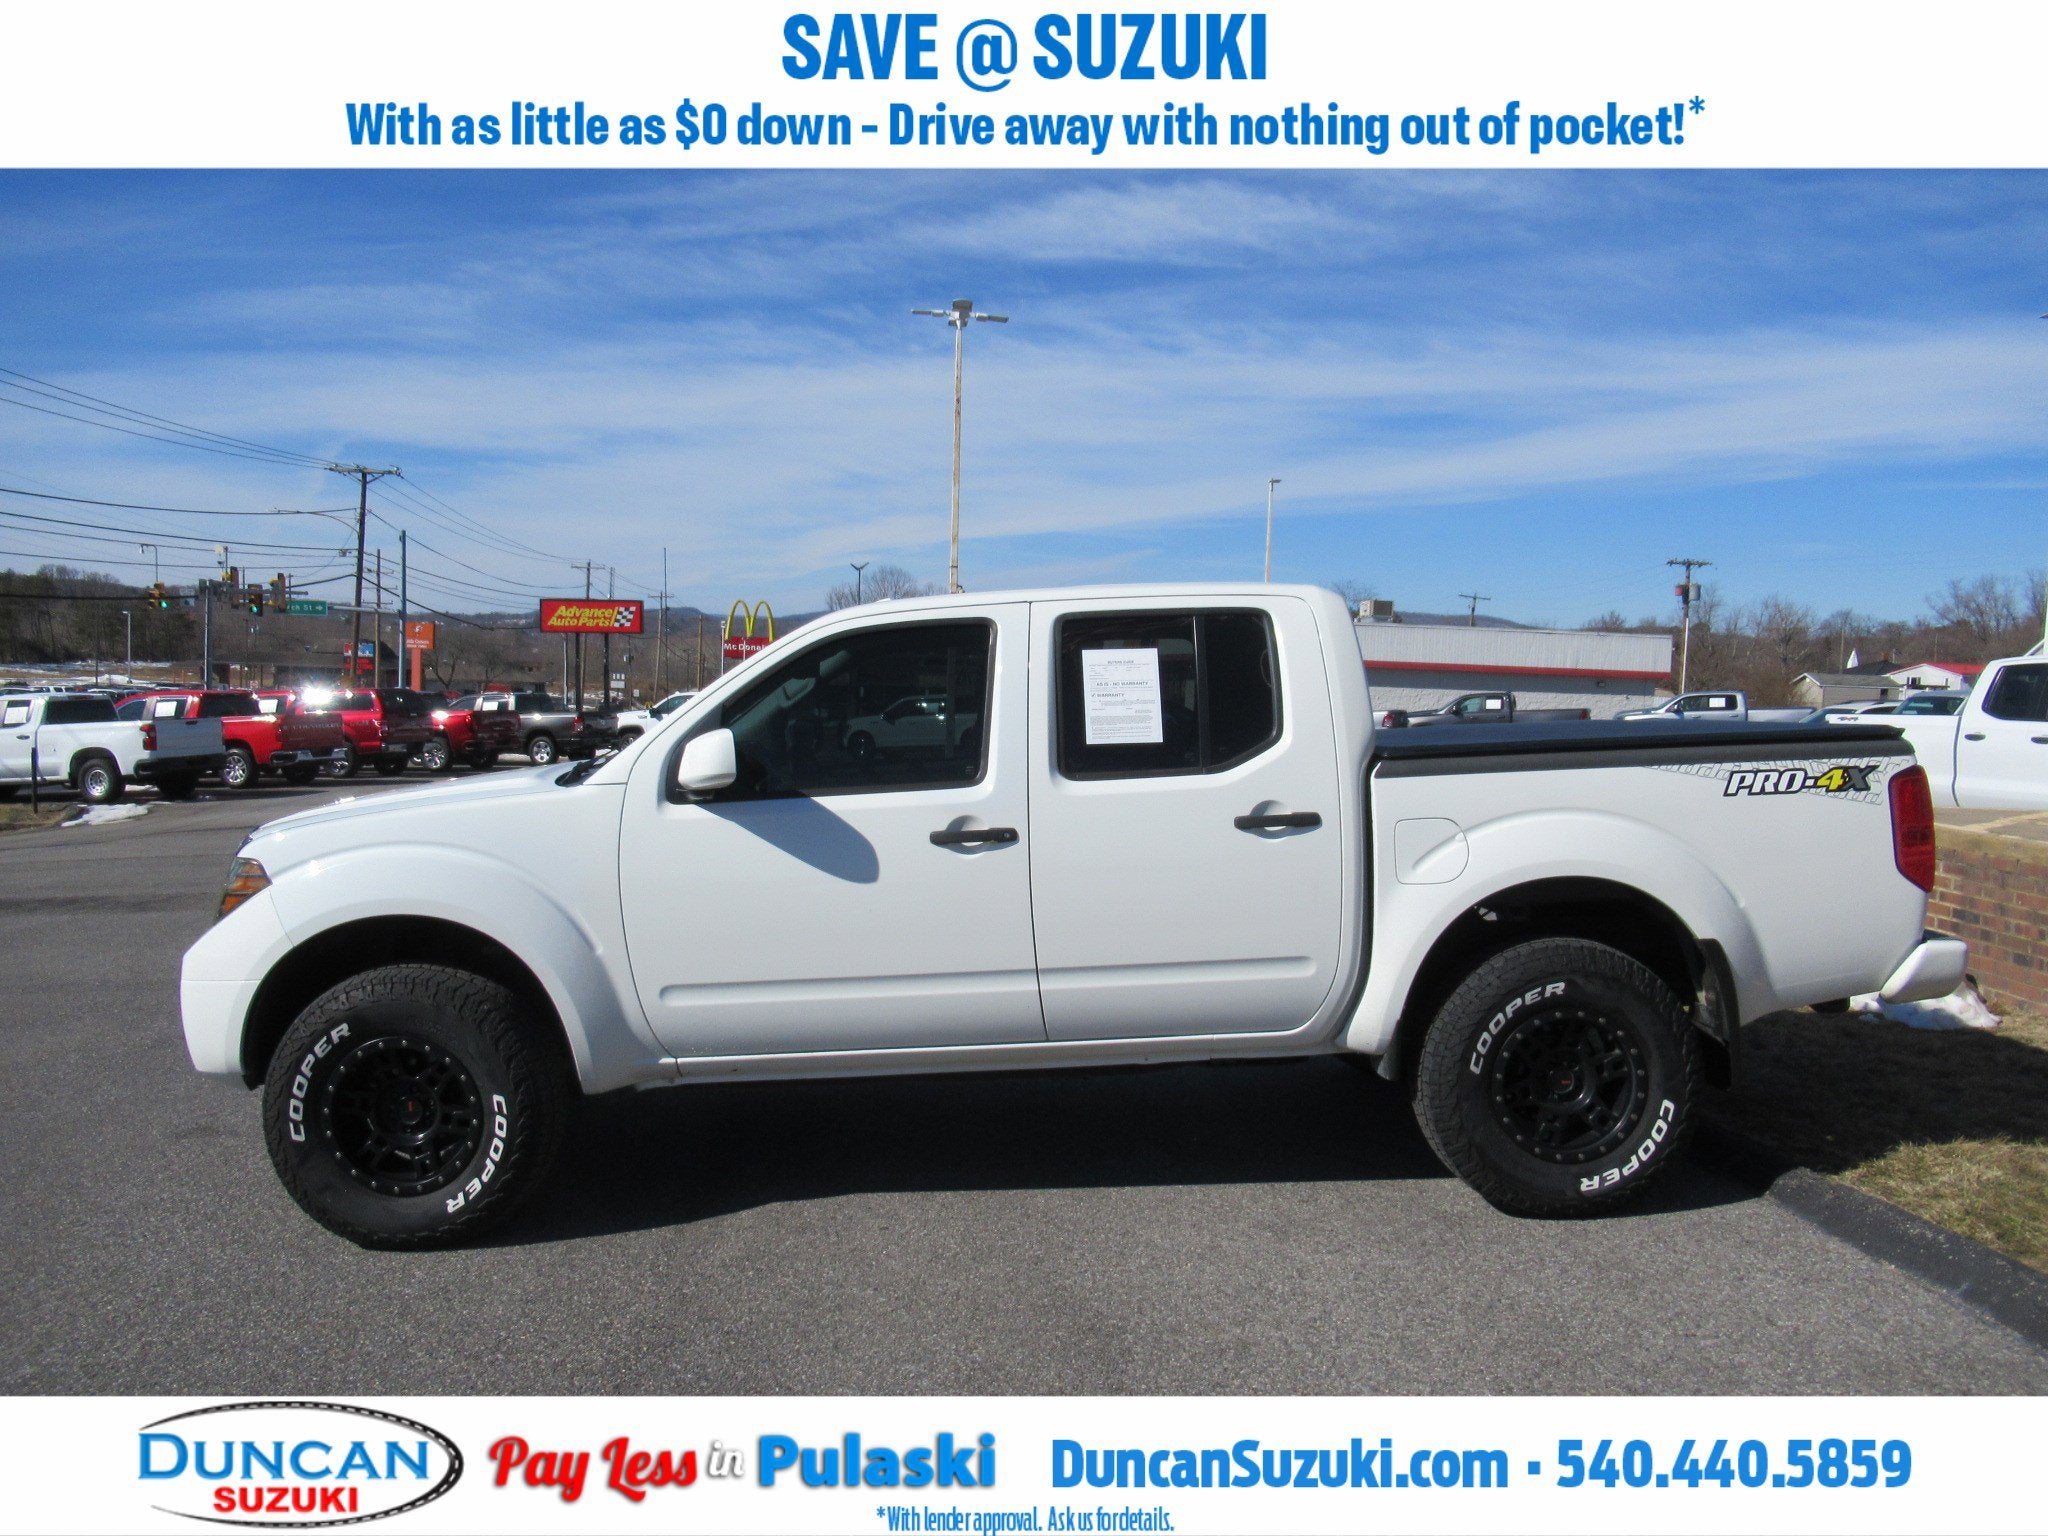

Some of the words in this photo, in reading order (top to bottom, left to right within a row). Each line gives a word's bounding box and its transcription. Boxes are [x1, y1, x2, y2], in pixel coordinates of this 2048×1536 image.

[547, 616, 578, 626] Auto
[555, 605, 613, 617] Advance
[1724, 765, 1880, 796] PRO-4X
[1469, 981, 1566, 1075] COOPER
[289, 1022, 351, 1143] COOPER
[446, 1094, 508, 1213] COOPER
[1580, 1099, 1675, 1192] COOPER
